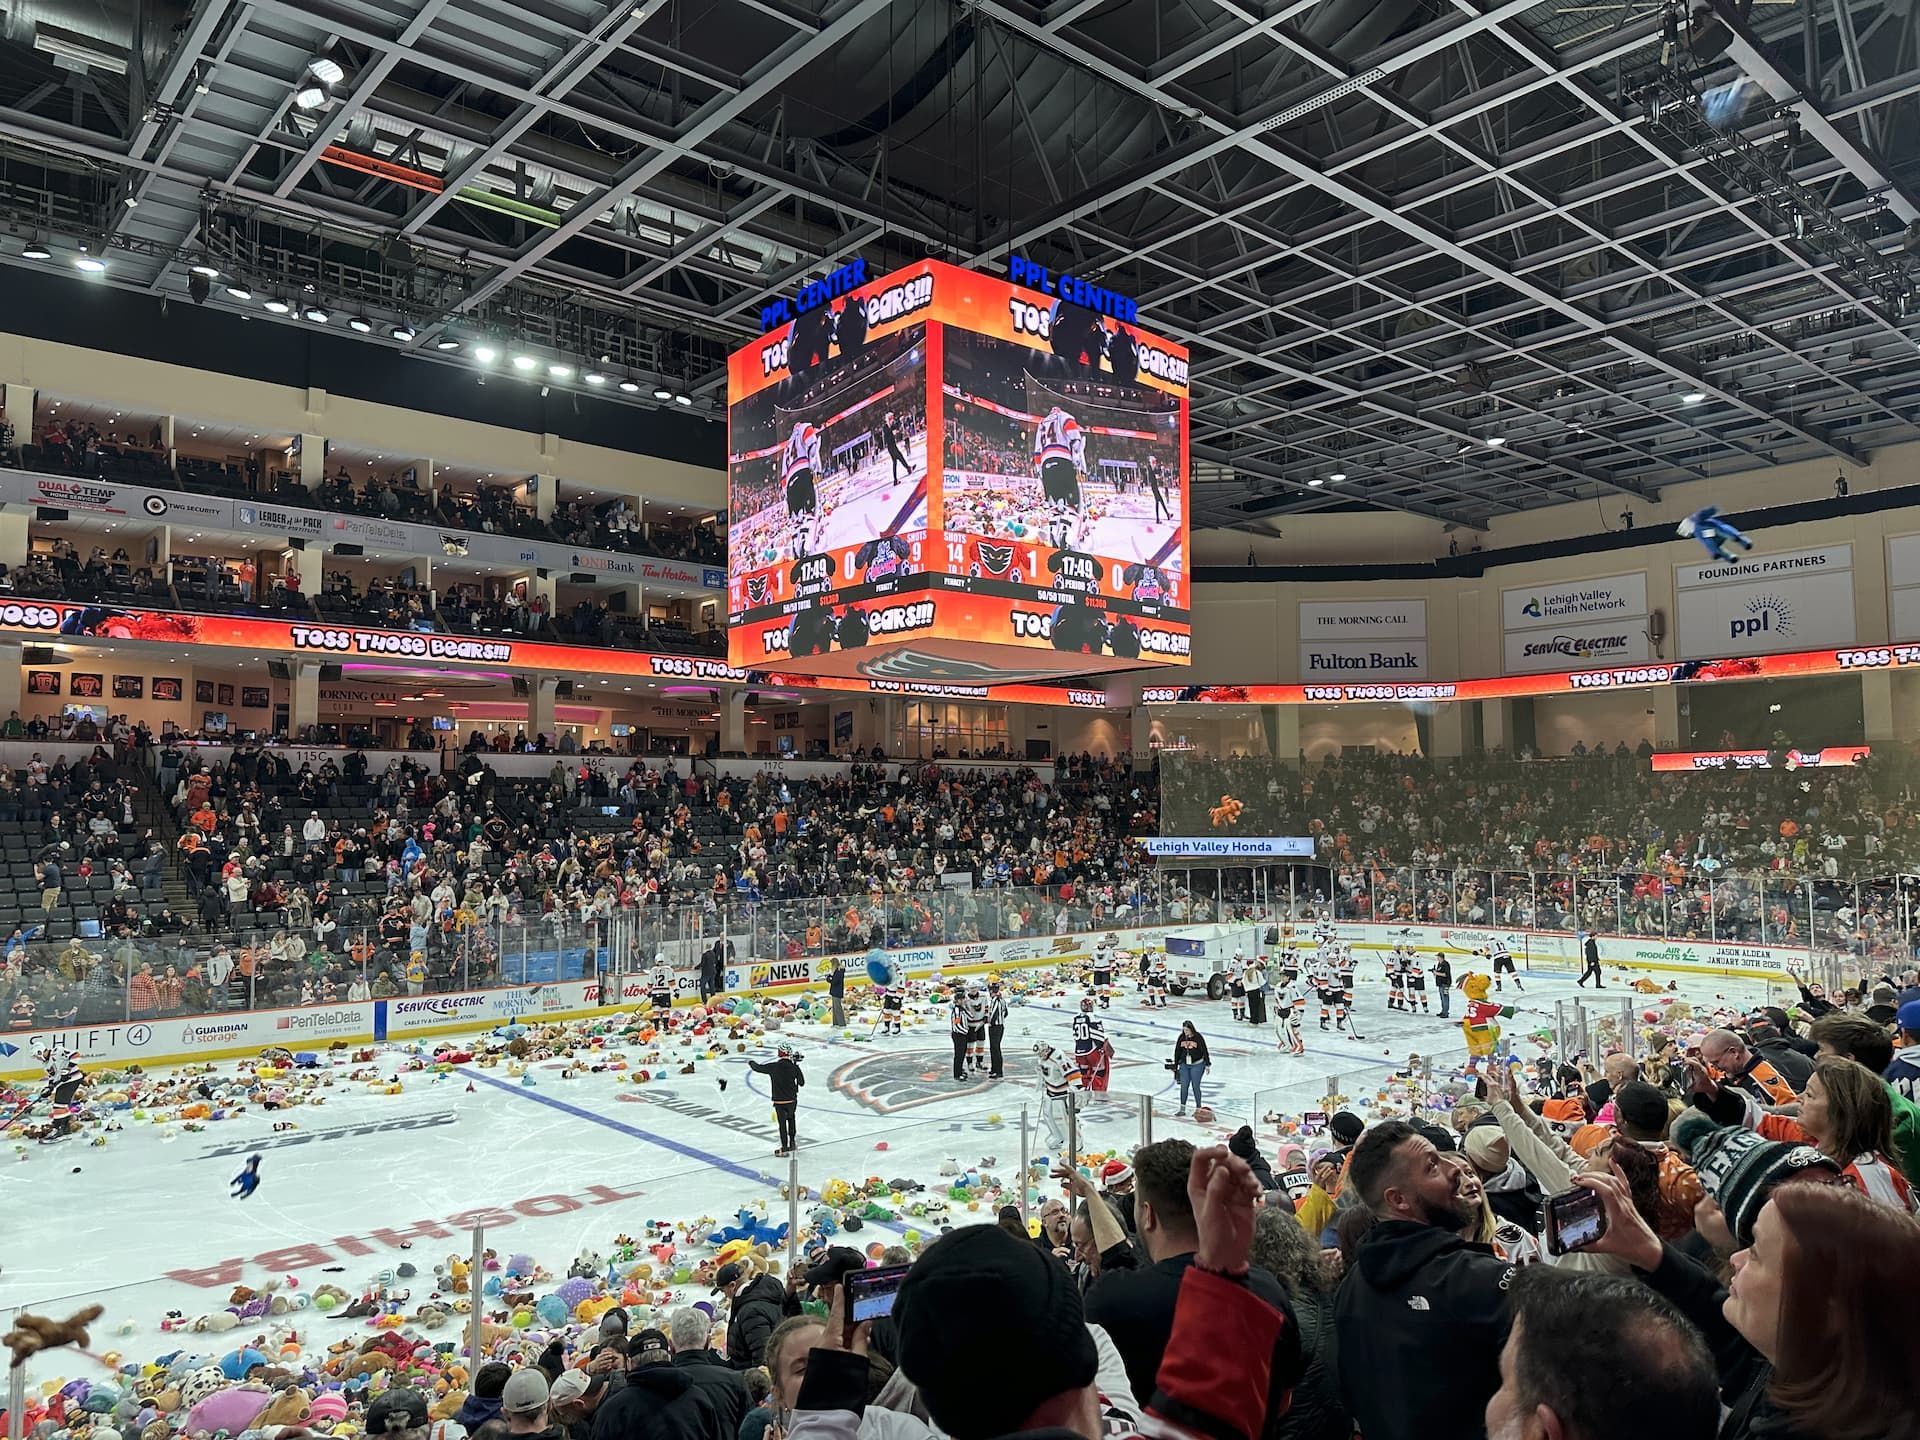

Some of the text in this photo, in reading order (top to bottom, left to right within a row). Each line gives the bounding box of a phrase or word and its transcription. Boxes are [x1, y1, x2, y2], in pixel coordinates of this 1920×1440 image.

[760, 257, 867, 333] PPL CENTER
[1010, 255, 1139, 325] PPL CENTER
[38, 480, 116, 498] DUAL TEMP
[69, 494, 101, 503] SERVICES
[168, 503, 221, 515] TWG SECURITY
[259, 510, 286, 524] LEADER
[303, 518, 322, 529] PACK
[944, 532, 967, 545] SHOTS
[520, 551, 534, 561] ppl
[912, 542, 921, 562] 9
[947, 544, 964, 563] 14
[800, 559, 827, 582] 17:49
[844, 551, 855, 580] 0
[1027, 551, 1037, 578] 1
[1062, 556, 1093, 579] 17:49
[1698, 555, 1826, 580] FOUNDING PARTNERS
[641, 563, 698, 583] Tim Hortons
[1112, 564, 1123, 591] 0
[775, 572, 784, 596] 1
[1064, 579, 1086, 591] PERIOD
[1170, 582, 1178, 597] 9
[1037, 590, 1076, 605] 50/50 TOTAL
[1544, 590, 1612, 606] Lehigh Valley
[1544, 598, 1626, 616] Health Network
[1316, 615, 1408, 625] THE MORNING CALL
[1730, 610, 1768, 638] ppl
[292, 628, 350, 649] TOSS
[1309, 652, 1419, 670] Fulton Bank
[1836, 649, 1890, 667] TOSS
[651, 658, 692, 674] TOSS
[1569, 674, 1611, 688] TOSS
[370, 691, 397, 701] CALL
[1068, 691, 1092, 705] TOSS
[1304, 687, 1342, 700] TOSS
[1660, 740, 1674, 748] 121
[297, 751, 327, 762] 115C
[1135, 751, 1150, 760] 119
[763, 761, 784, 770] 117C
[1150, 841, 1272, 854] Lehigh Valley Honda
[1635, 950, 1681, 961] PRODUCTS
[1665, 946, 1680, 955] AIR
[1716, 947, 1771, 959] JASON ALDEAN
[1707, 956, 1740, 966] JANUARY
[1741, 957, 1761, 967] 30TH
[750, 963, 809, 985] 69 NEWS
[505, 991, 522, 999] THE
[395, 996, 486, 1014] SERVICE ELECTRIC
[493, 997, 536, 1009] MORNING
[432, 1014, 478, 1023] COMMUNICATIONS
[503, 1006, 527, 1016] CALL
[290, 1010, 362, 1029] PenTeleData
[133, 1028, 143, 1042] 4
[195, 1023, 248, 1036] GUARDIAN
[1072, 1023, 1090, 1041] 30
[197, 1032, 238, 1044] storage
[161, 1183, 647, 1290] TOSHIBA
